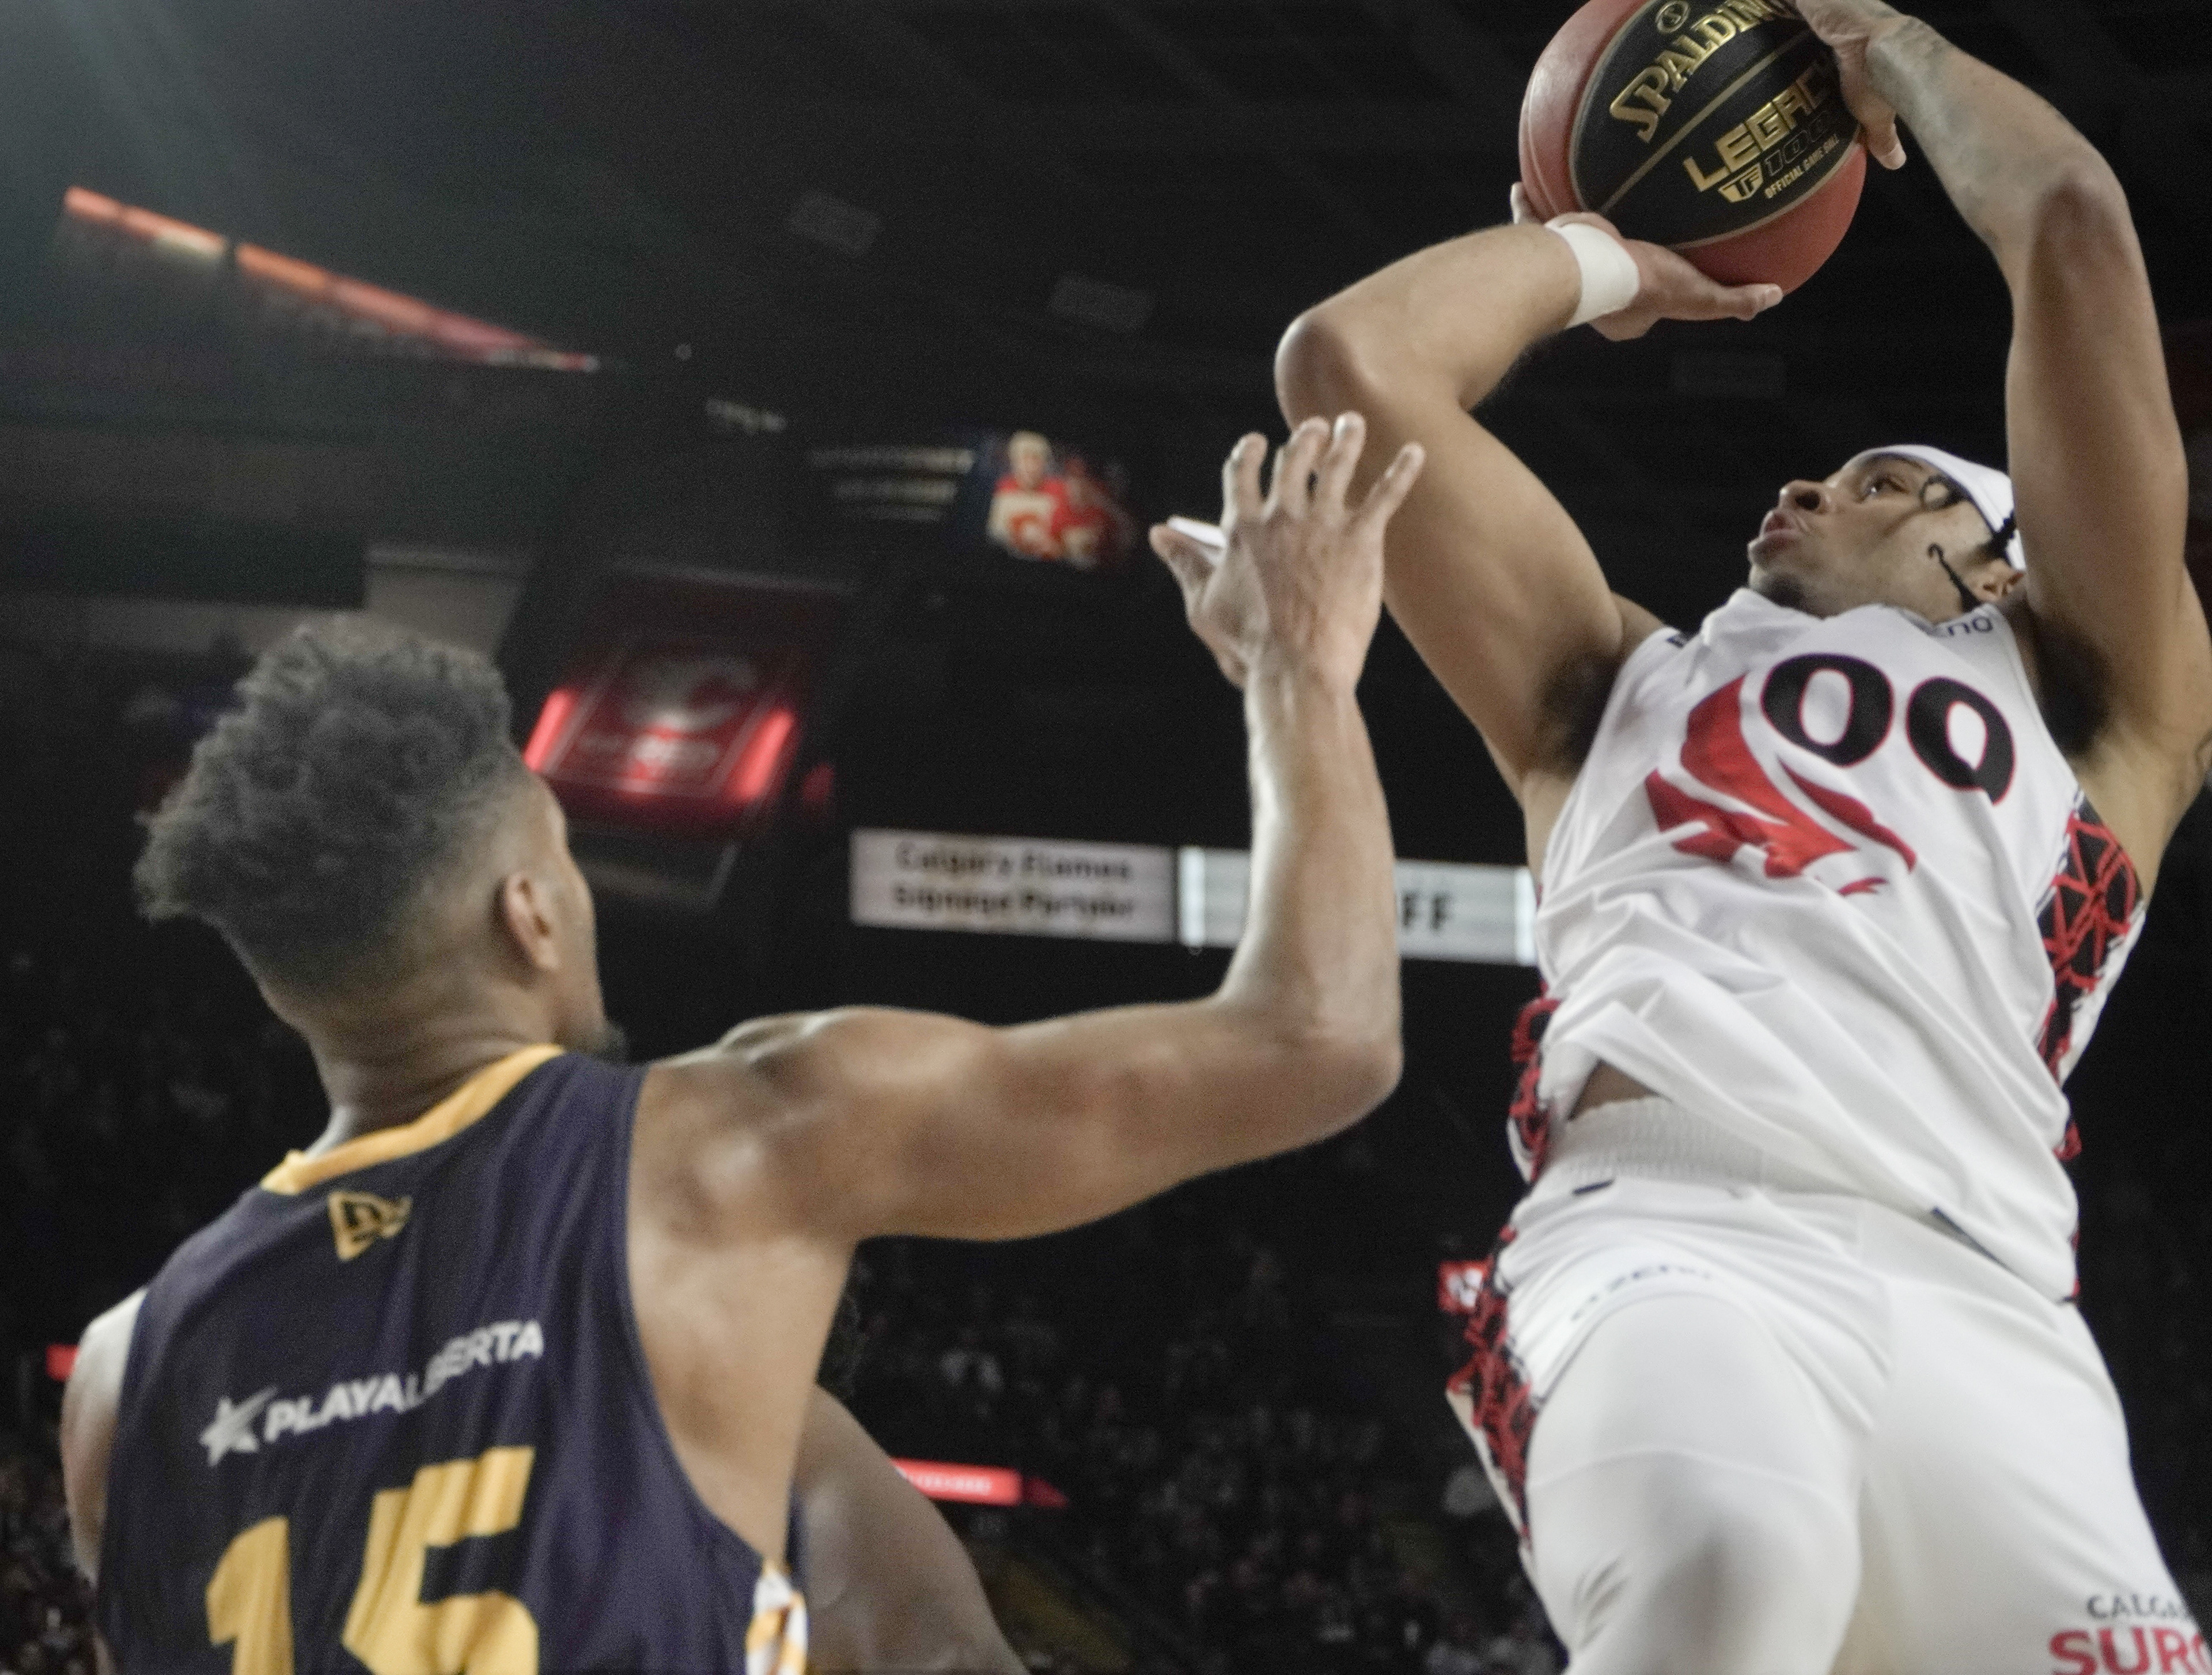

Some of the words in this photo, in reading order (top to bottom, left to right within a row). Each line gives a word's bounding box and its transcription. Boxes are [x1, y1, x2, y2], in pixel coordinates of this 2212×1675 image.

[1683, 66, 1825, 192] LEGAC
[1764, 165, 1805, 199] OFFICIAL
[1760, 652, 2016, 806] 00
[205, 1446, 539, 1675] 15
